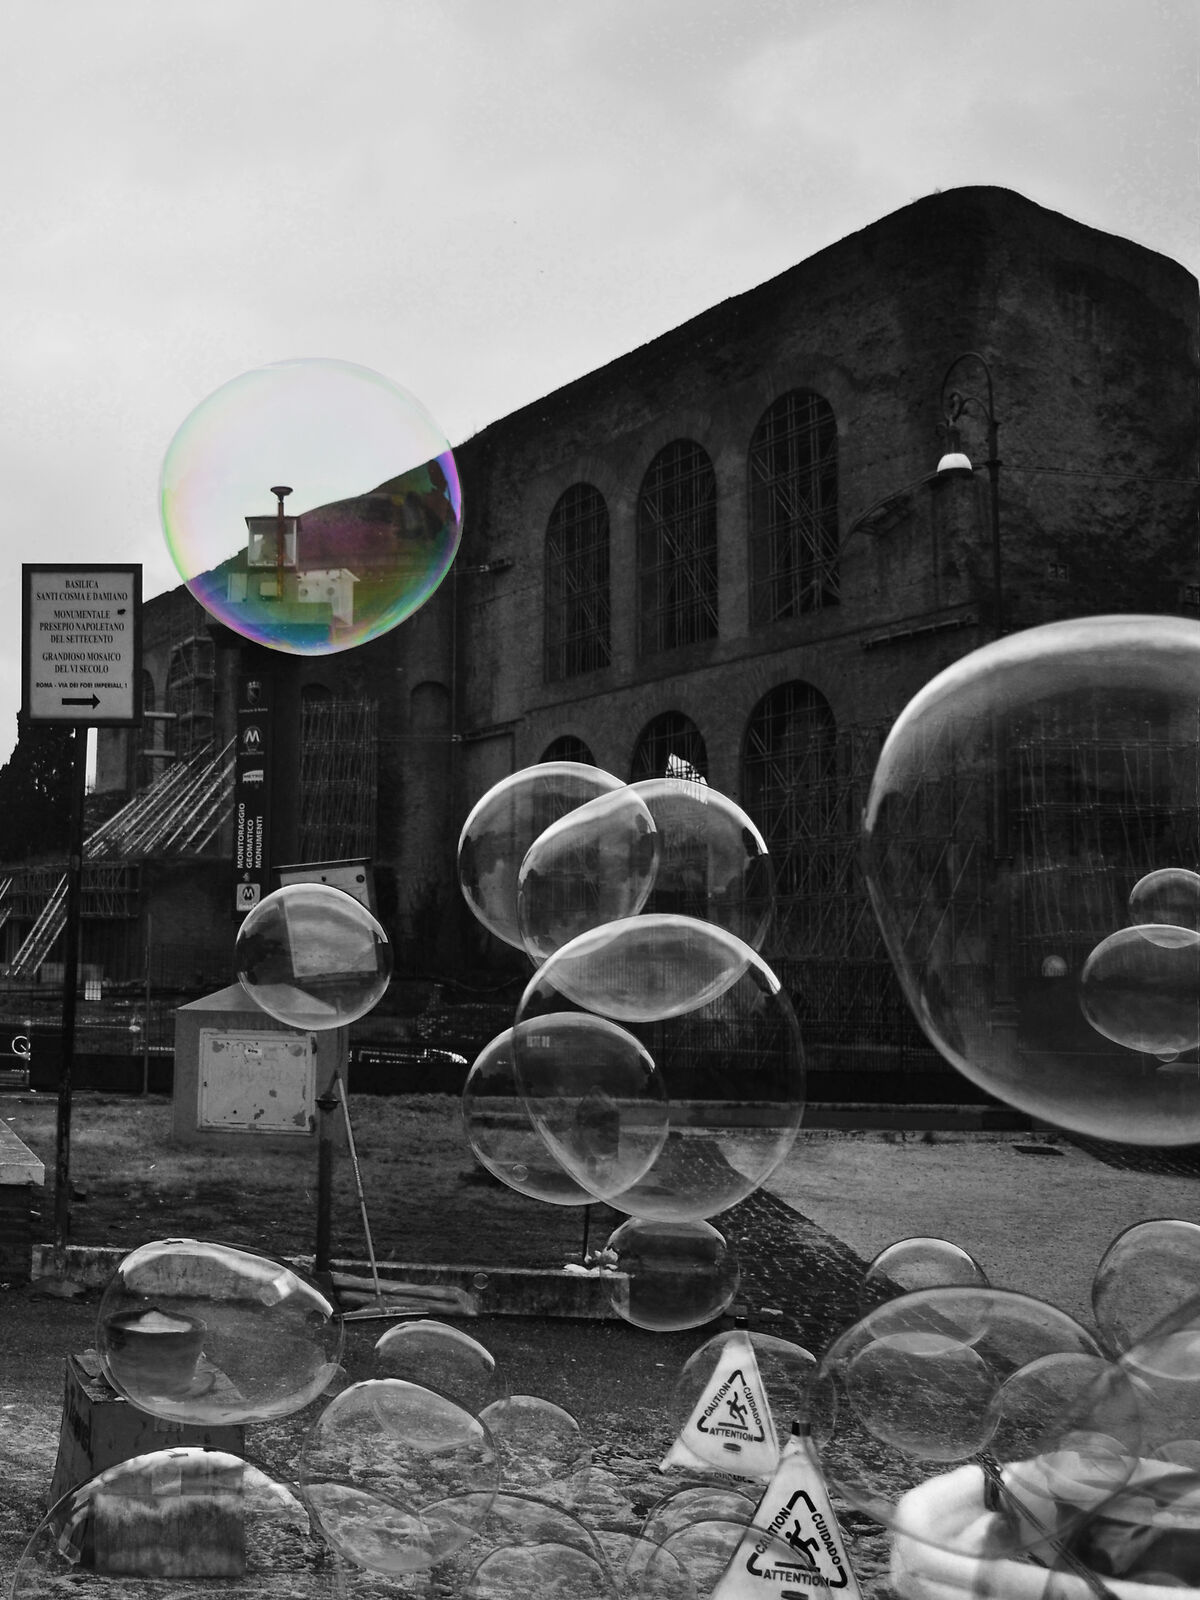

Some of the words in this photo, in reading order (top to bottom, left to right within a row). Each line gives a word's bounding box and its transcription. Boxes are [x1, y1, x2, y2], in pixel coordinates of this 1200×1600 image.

[65, 580, 99, 589] BASILICA
[36, 592, 58, 600] SANTI
[59, 592, 85, 600] COSMA
[87, 592, 92, 600] E
[93, 592, 128, 600] DAMIANO
[54, 610, 111, 619] MONUMENTALE
[39, 622, 74, 631] PRESEPIO
[76, 622, 124, 631] NAPOLETANO
[51, 635, 65, 643] DEL
[66, 635, 113, 643] SETTECENTO
[42, 652, 86, 661] GRANDIOSO
[87, 652, 121, 661] MOSAICO
[54, 664, 70, 673] DEL
[70, 664, 78, 673] VI
[79, 664, 109, 673] SECOLO
[237, 803, 245, 869] MONITORAGGIO
[255, 816, 263, 869] MONUMENTI
[246, 819, 254, 869] GEOMATICO
[704, 1382, 731, 1417] CAUTION
[743, 1386, 761, 1425] CUIDADO
[709, 1427, 754, 1442] ATTENTION
[811, 1513, 841, 1565] CUIDADO
[763, 1569, 829, 1588] ATTENTION
